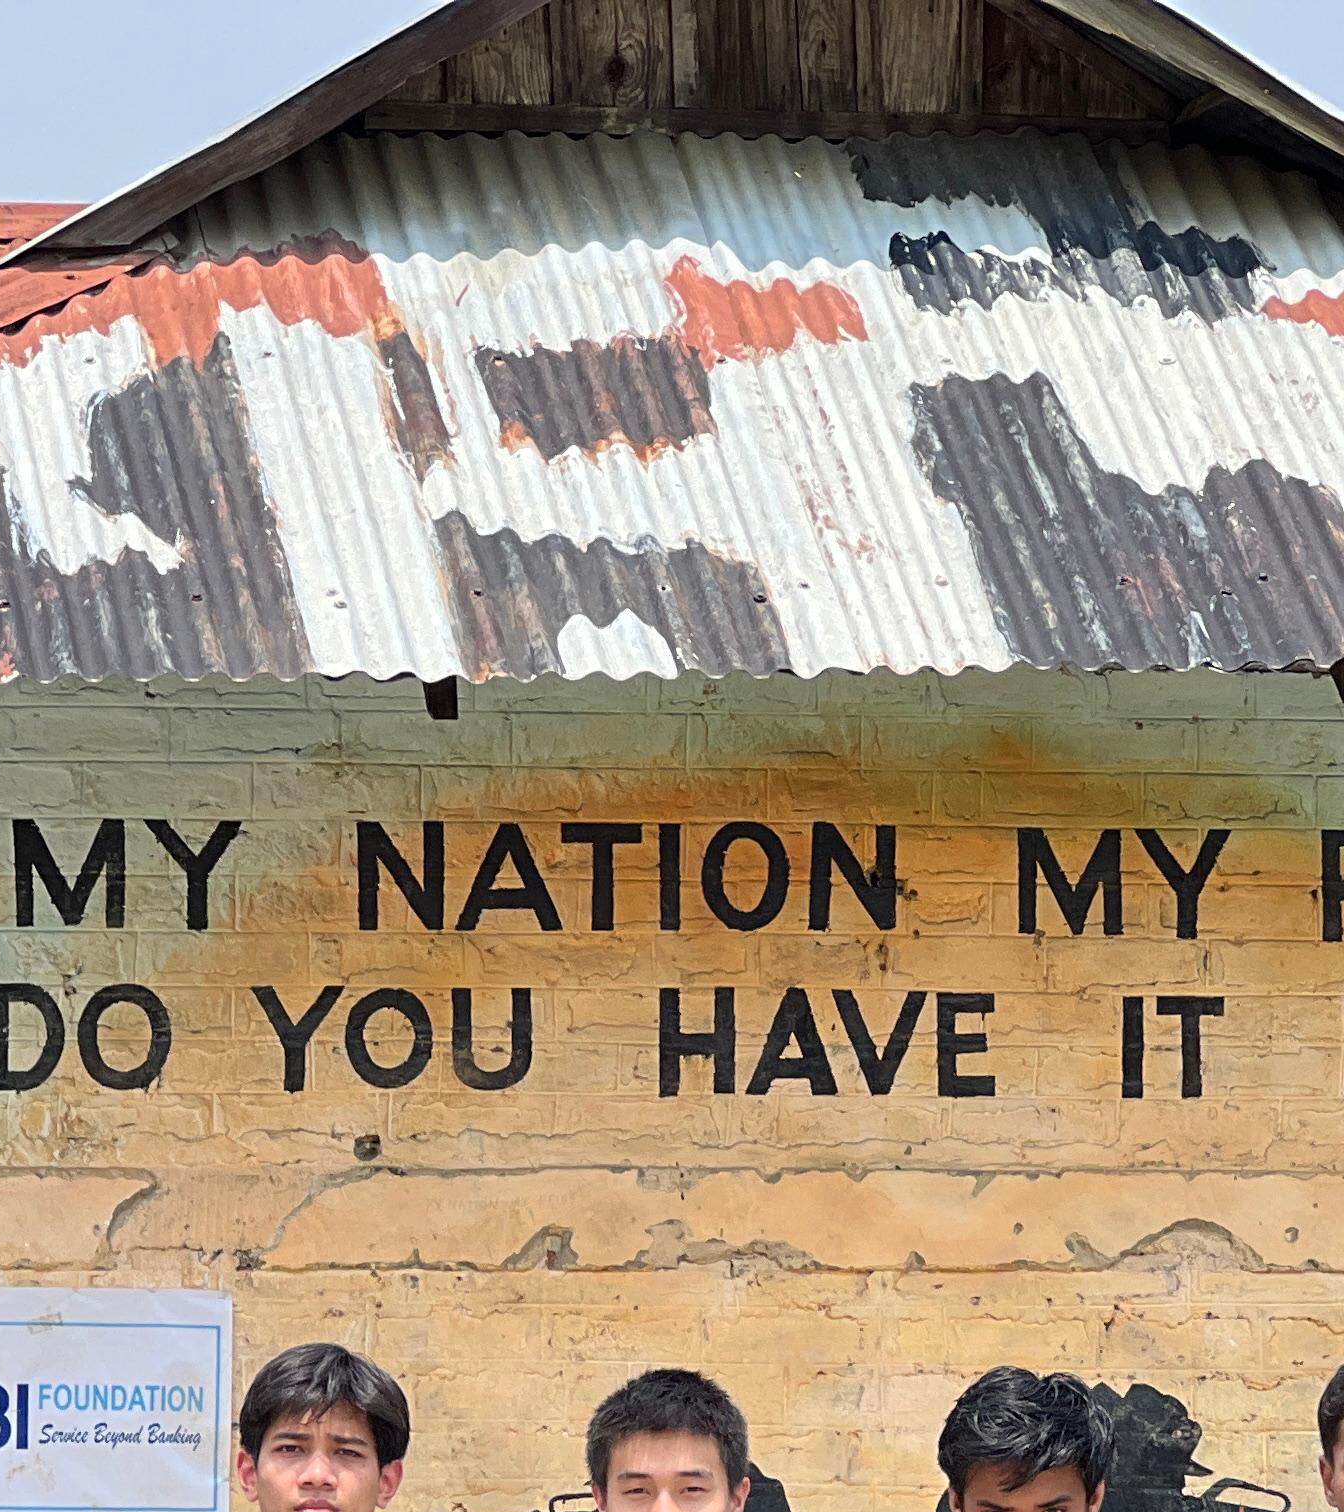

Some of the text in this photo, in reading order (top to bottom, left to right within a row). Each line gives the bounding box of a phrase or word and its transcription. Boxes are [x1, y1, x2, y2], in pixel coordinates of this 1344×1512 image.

[11, 817, 243, 932] MY
[355, 819, 896, 933] NATION
[1017, 827, 1233, 940] MY
[249, 985, 533, 1095] YOU
[658, 986, 996, 1098] HAVE
[1121, 995, 1225, 1099] IT
[38, 1383, 204, 1412] FOUNDATION
[38, 1422, 201, 1451] Service Beyond Banking
